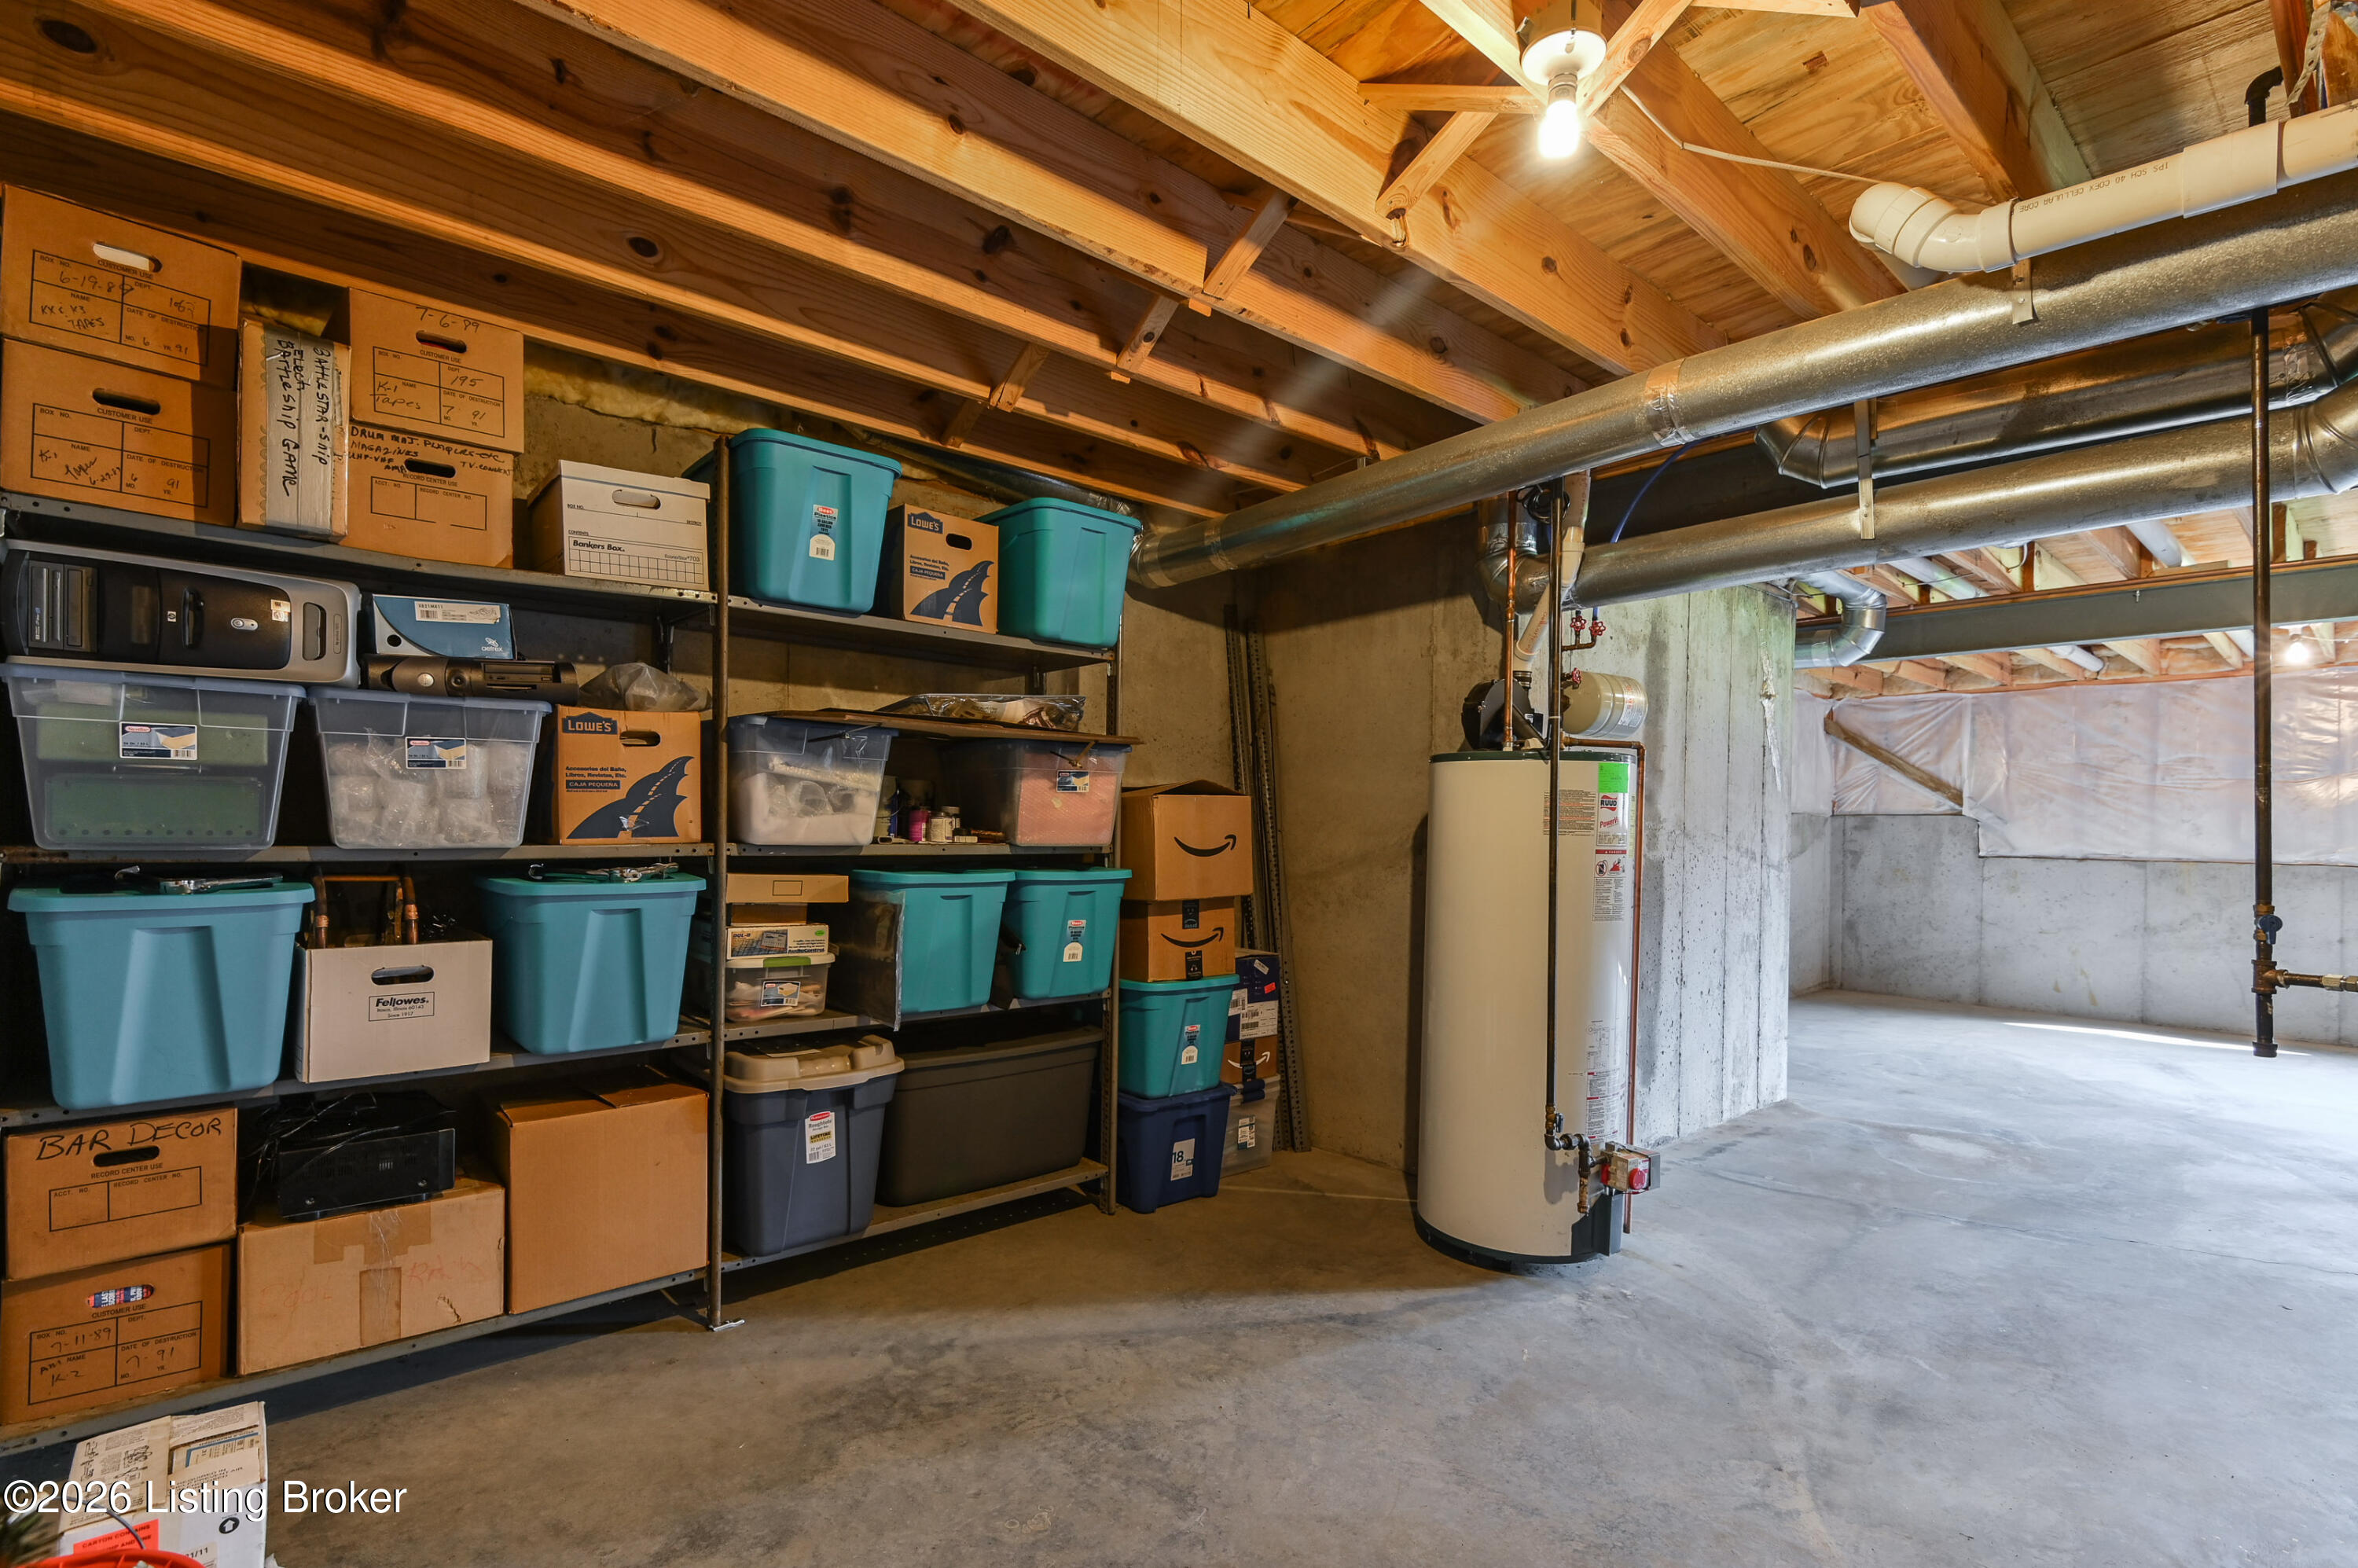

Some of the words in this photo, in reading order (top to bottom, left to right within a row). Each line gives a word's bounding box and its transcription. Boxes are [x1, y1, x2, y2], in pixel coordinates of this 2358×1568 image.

[2153, 162, 2169, 172] IPS
[2115, 175, 2126, 184] 40
[2131, 169, 2147, 179] SCH
[2088, 181, 2110, 192] COEX
[2044, 187, 2084, 206] CELLULAR
[2019, 201, 2039, 213] CORE
[97, 259, 138, 277] CUSTOMER
[139, 270, 154, 281] USE
[71, 292, 90, 302] NAME
[127, 306, 145, 317] DATE
[420, 349, 448, 362] CUSTOMER
[39, 407, 55, 417] BOX
[97, 406, 137, 422] CUSTOMER
[138, 415, 153, 425] USE
[71, 443, 91, 453] NAME
[127, 453, 144, 462] DATE
[426, 476, 447, 486] CENTER
[911, 515, 940, 532] LOWE'S
[573, 539, 605, 550] Bankers
[567, 718, 613, 733] LOWE'S
[35, 1129, 112, 1161] BAR
[127, 1116, 222, 1147] DECOR
[1172, 1150, 1184, 1163] 18
[90, 1169, 120, 1180] RECORD
[121, 1165, 149, 1176] CENTER
[150, 1162, 163, 1170] USE
[113, 1178, 139, 1188] RECORD
[143, 1173, 168, 1184] CENTER
[91, 1305, 131, 1319] CUSTOMER
[132, 1303, 147, 1313] USE
[121, 1342, 138, 1352] DATE
[154, 1331, 197, 1345] DESTRUCTION
[66, 1353, 86, 1363] NAME
[82, 1534, 114, 1548] CARTON
